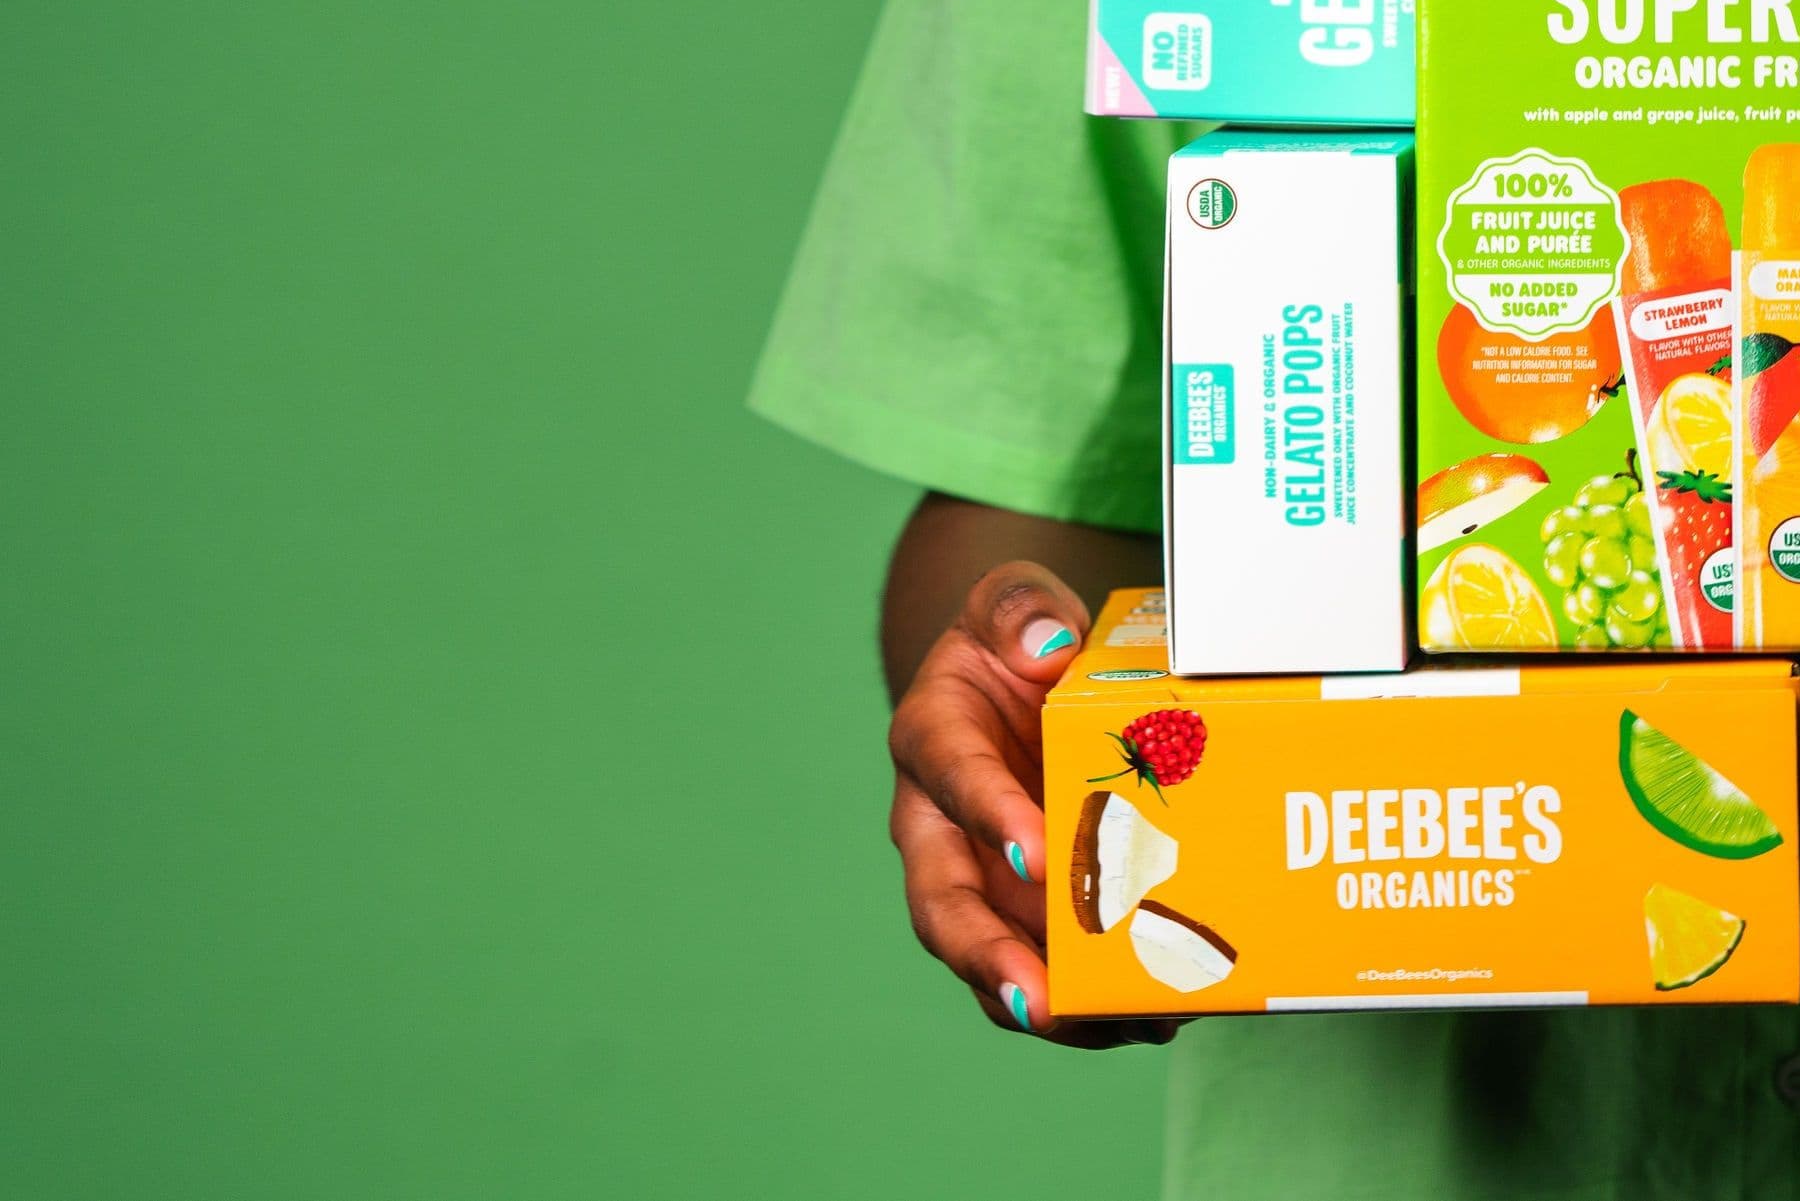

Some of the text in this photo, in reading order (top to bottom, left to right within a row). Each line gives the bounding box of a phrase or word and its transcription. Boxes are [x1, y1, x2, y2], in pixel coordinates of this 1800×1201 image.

[1153, 31, 1174, 70] NO
[1176, 23, 1188, 81] REFINED
[1191, 27, 1202, 78] SUGARS
[1575, 55, 1741, 89] ORGANIC
[1524, 106, 1560, 121] with
[1564, 107, 1608, 125] apple
[1612, 107, 1643, 121] and
[1647, 109, 1693, 124] grape
[1696, 106, 1740, 123] juice,
[1744, 106, 1780, 121] fruit
[1494, 173, 1573, 198] 100%
[1200, 190, 1210, 218] USDA
[1214, 185, 1223, 222] ORGANIC
[1472, 211, 1596, 230] FRUIT JUICE
[1475, 229, 1592, 254] AND PURÉE
[1457, 259, 1611, 269] & OTHER ORGANIC INGREDIENTS
[1490, 283, 1578, 297] NO ADDED
[1644, 298, 1723, 321] STRAWBERRY
[1760, 303, 1791, 312] FLAVOR
[1765, 312, 1800, 321] NATURAL
[1665, 314, 1708, 331] LEMON
[1499, 347, 1505, 356] A
[1506, 347, 1521, 356] LOW
[1523, 347, 1551, 356] CALORIE
[1576, 347, 1588, 356] SEE
[1649, 340, 1680, 352] FLAVOR
[1682, 335, 1704, 346] WITH
[1655, 341, 1730, 361] NATURAL FLAVORS
[1472, 360, 1597, 369] NUTRITION INFORMATION FOR SUGAR
[1495, 373, 1510, 383] AND
[1511, 373, 1540, 383] CALORIE
[1188, 370, 1214, 457] DEEBEE'S
[1215, 385, 1226, 442] ORGANICS
[1263, 334, 1277, 498] NON-DAIRY & ORGANIC
[1282, 304, 1326, 526] GELATO POPS
[1331, 313, 1344, 517] SWEETENED ONLY WITH ORGANIC FRUIT
[1343, 302, 1356, 525] JUICE CONCENTRATE AND COCONUT WATER
[1713, 564, 1733, 579] US
[1285, 781, 1562, 870] DEEBEE'S
[1337, 868, 1515, 910] ORGANICS
